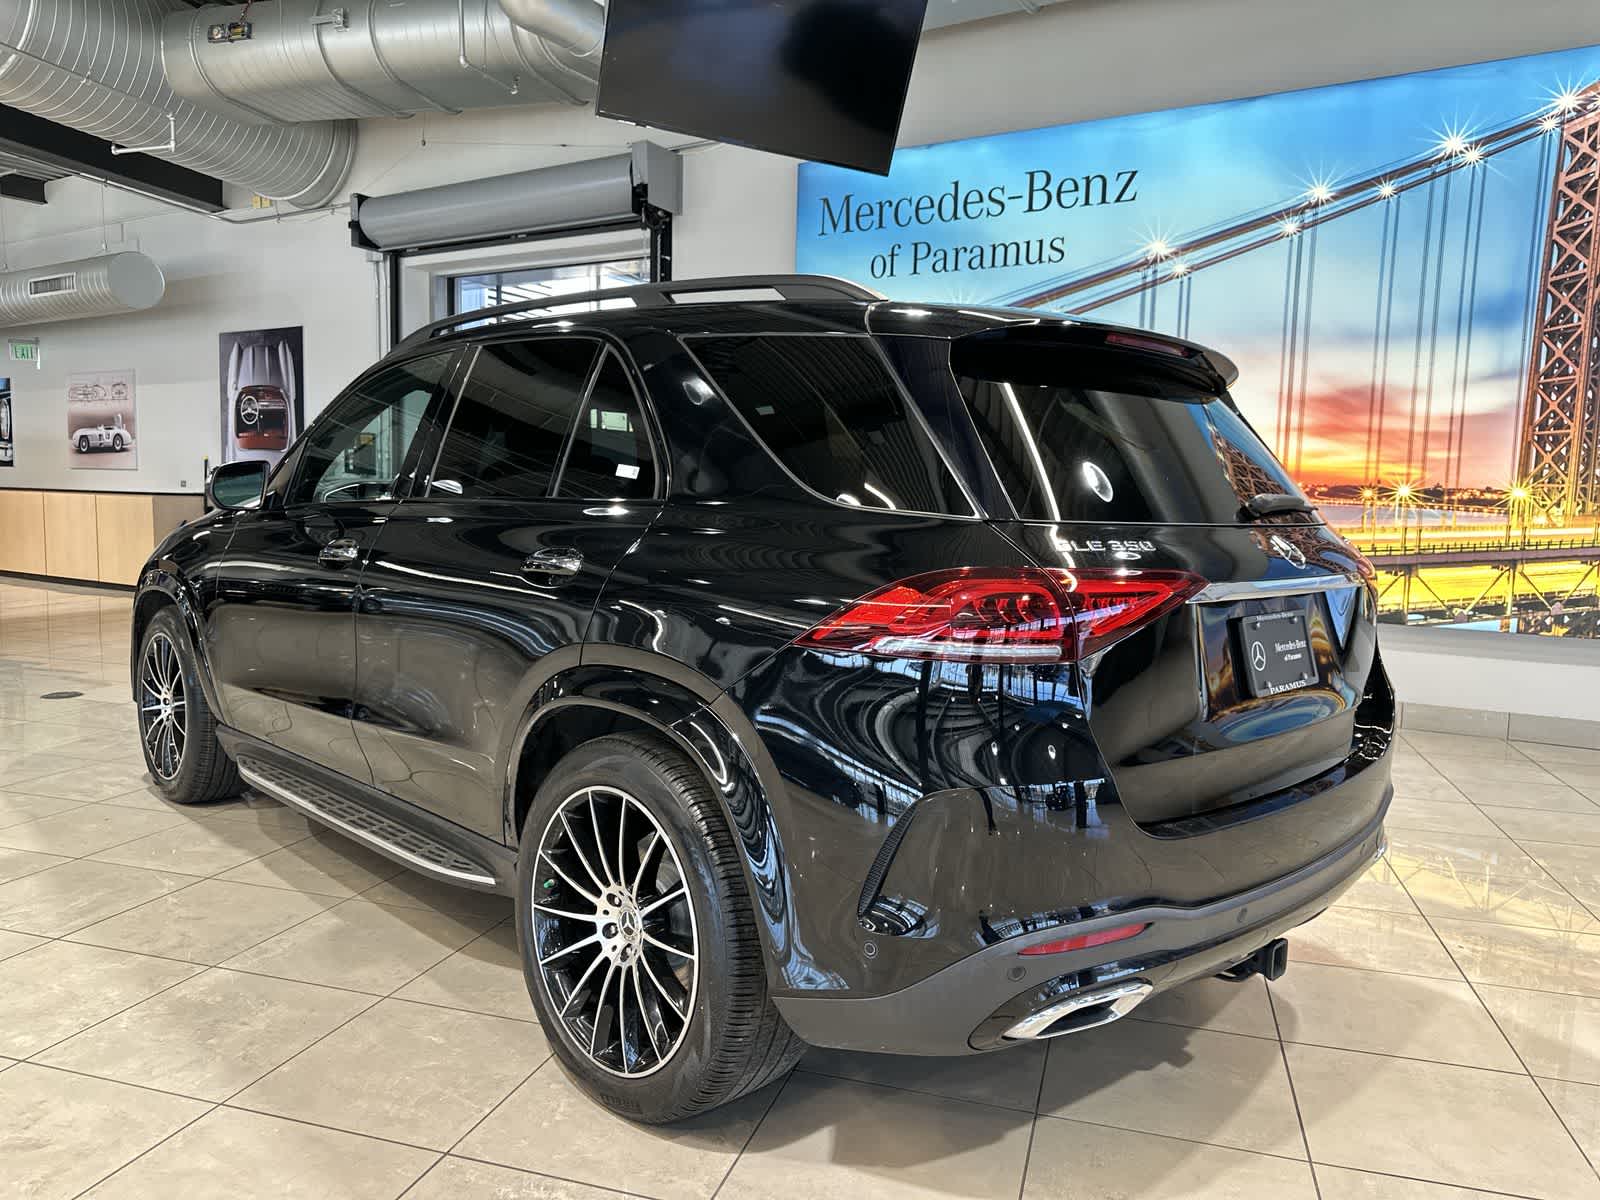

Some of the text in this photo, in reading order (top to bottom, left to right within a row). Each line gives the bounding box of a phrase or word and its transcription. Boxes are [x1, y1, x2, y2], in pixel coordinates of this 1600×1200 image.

[818, 169, 1138, 237] Mercedes-Benz
[870, 235, 1066, 279] of Paramus
[1270, 680, 1306, 694] PARAMUS
